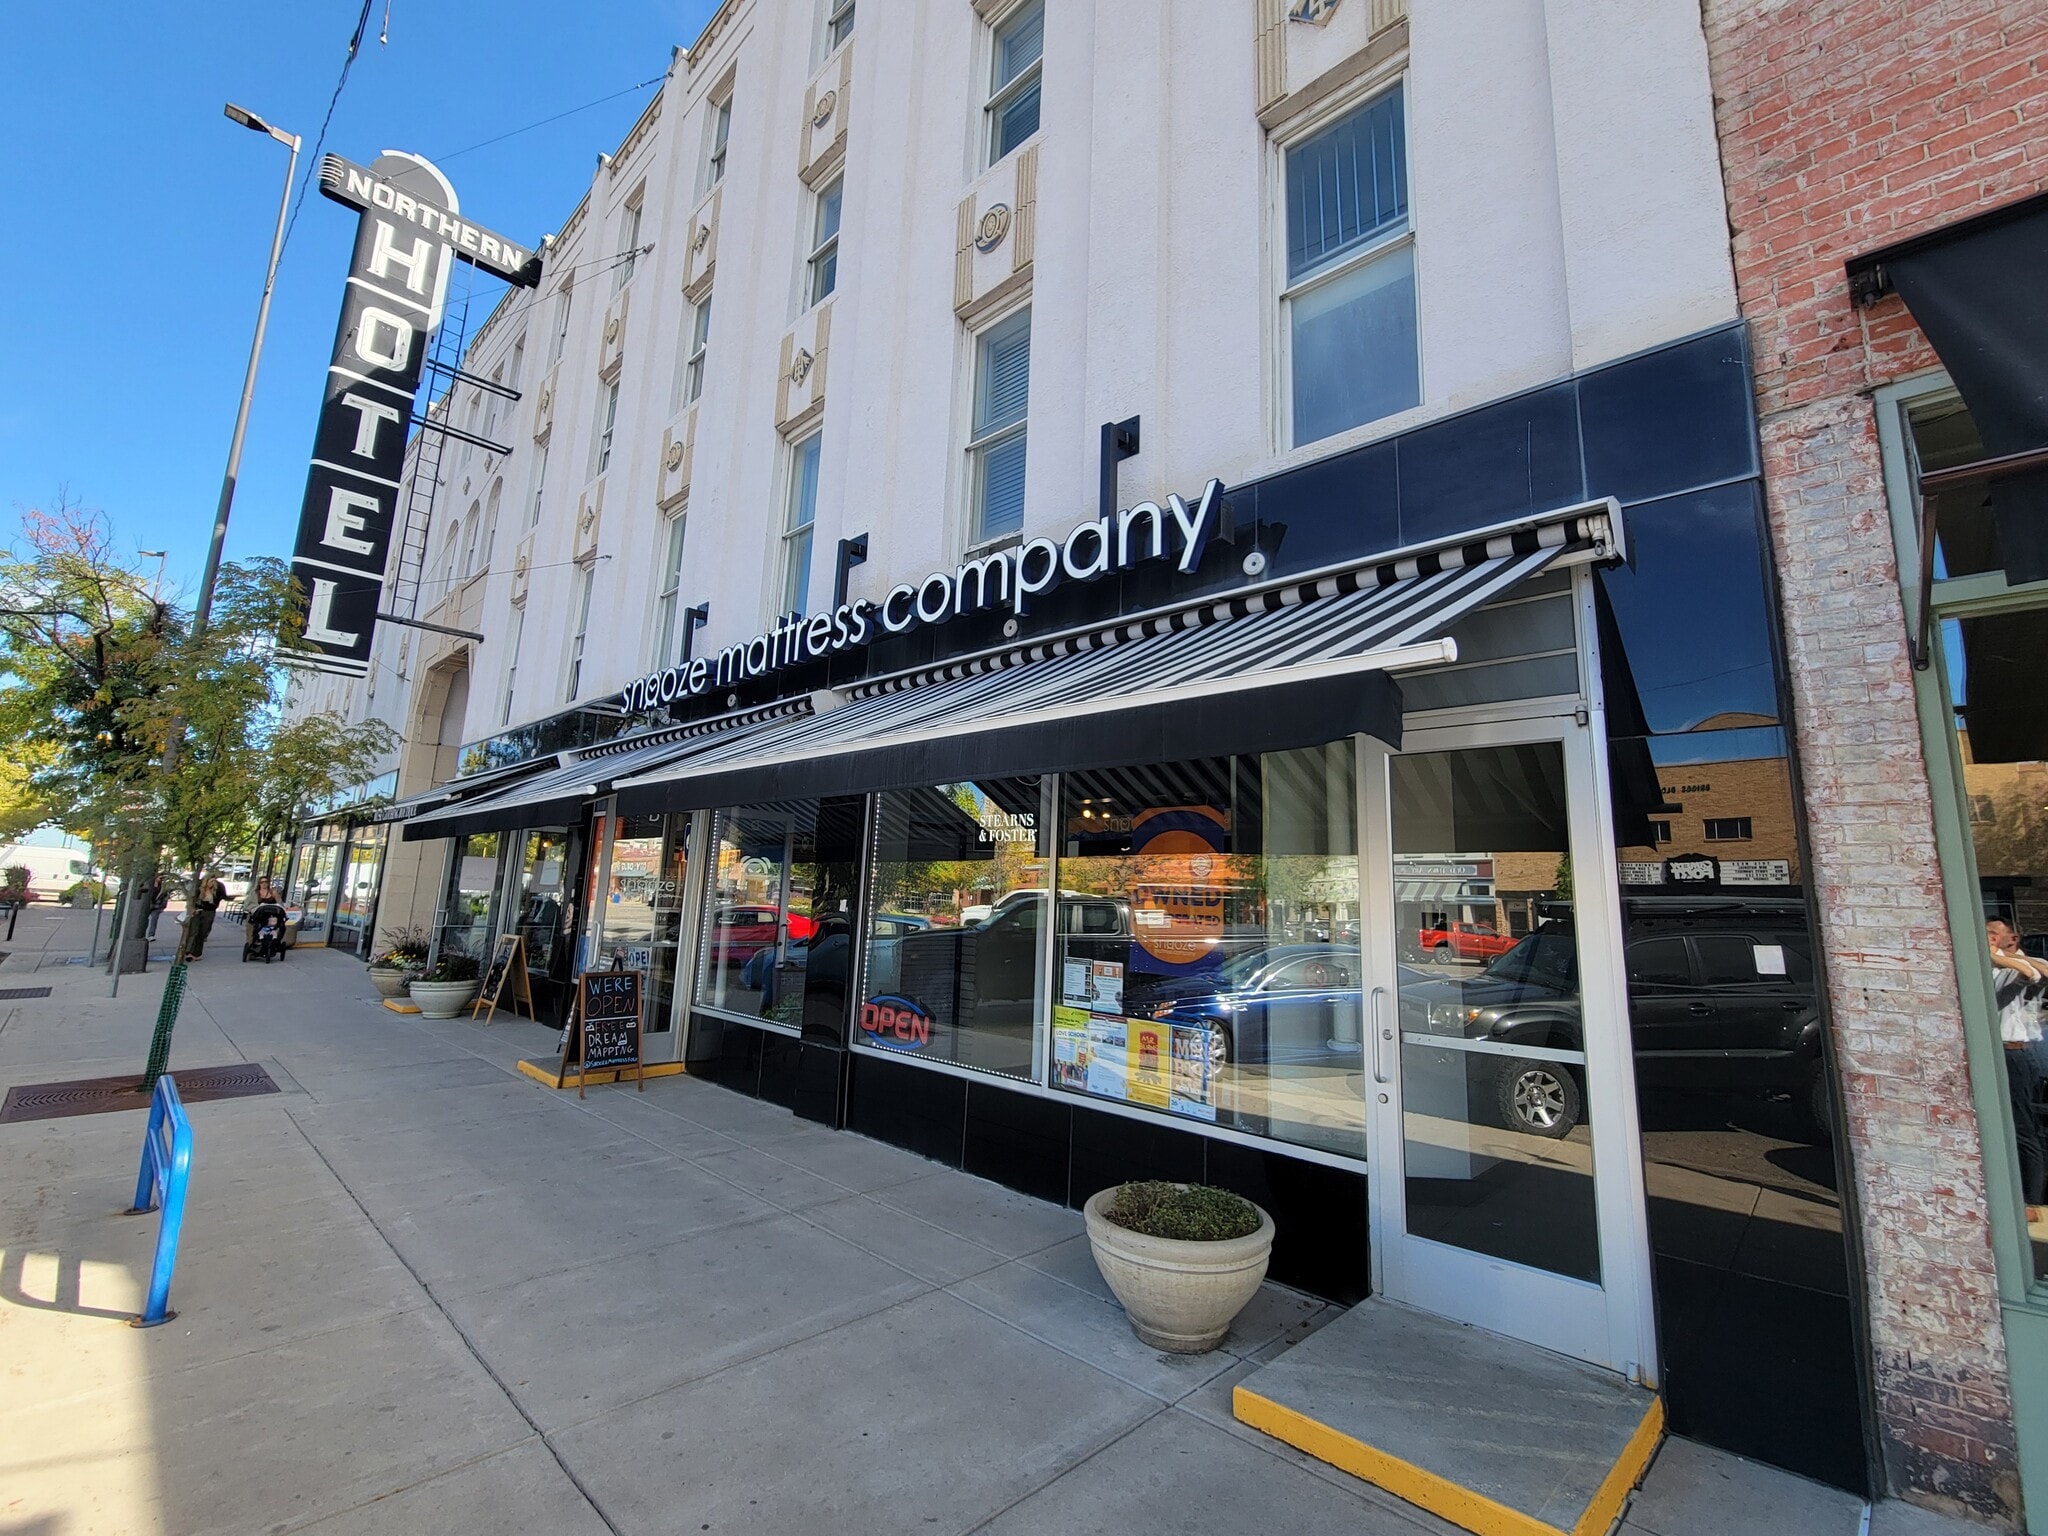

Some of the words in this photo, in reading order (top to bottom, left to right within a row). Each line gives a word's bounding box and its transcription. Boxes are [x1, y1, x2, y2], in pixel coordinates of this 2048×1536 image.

[346, 168, 523, 272] NORTHERN
[301, 218, 433, 649] HOTEL
[620, 656, 708, 714] snooze
[716, 597, 868, 686] mattress
[883, 477, 1224, 633] company
[979, 813, 1035, 828] STEARNS
[978, 829, 987, 842] &
[988, 828, 1038, 842] FOSTER
[586, 995, 636, 1017] OPEN
[860, 1002, 930, 1046] OPEN
[588, 1031, 628, 1048] DREAM
[587, 1045, 635, 1061] MAPPING
